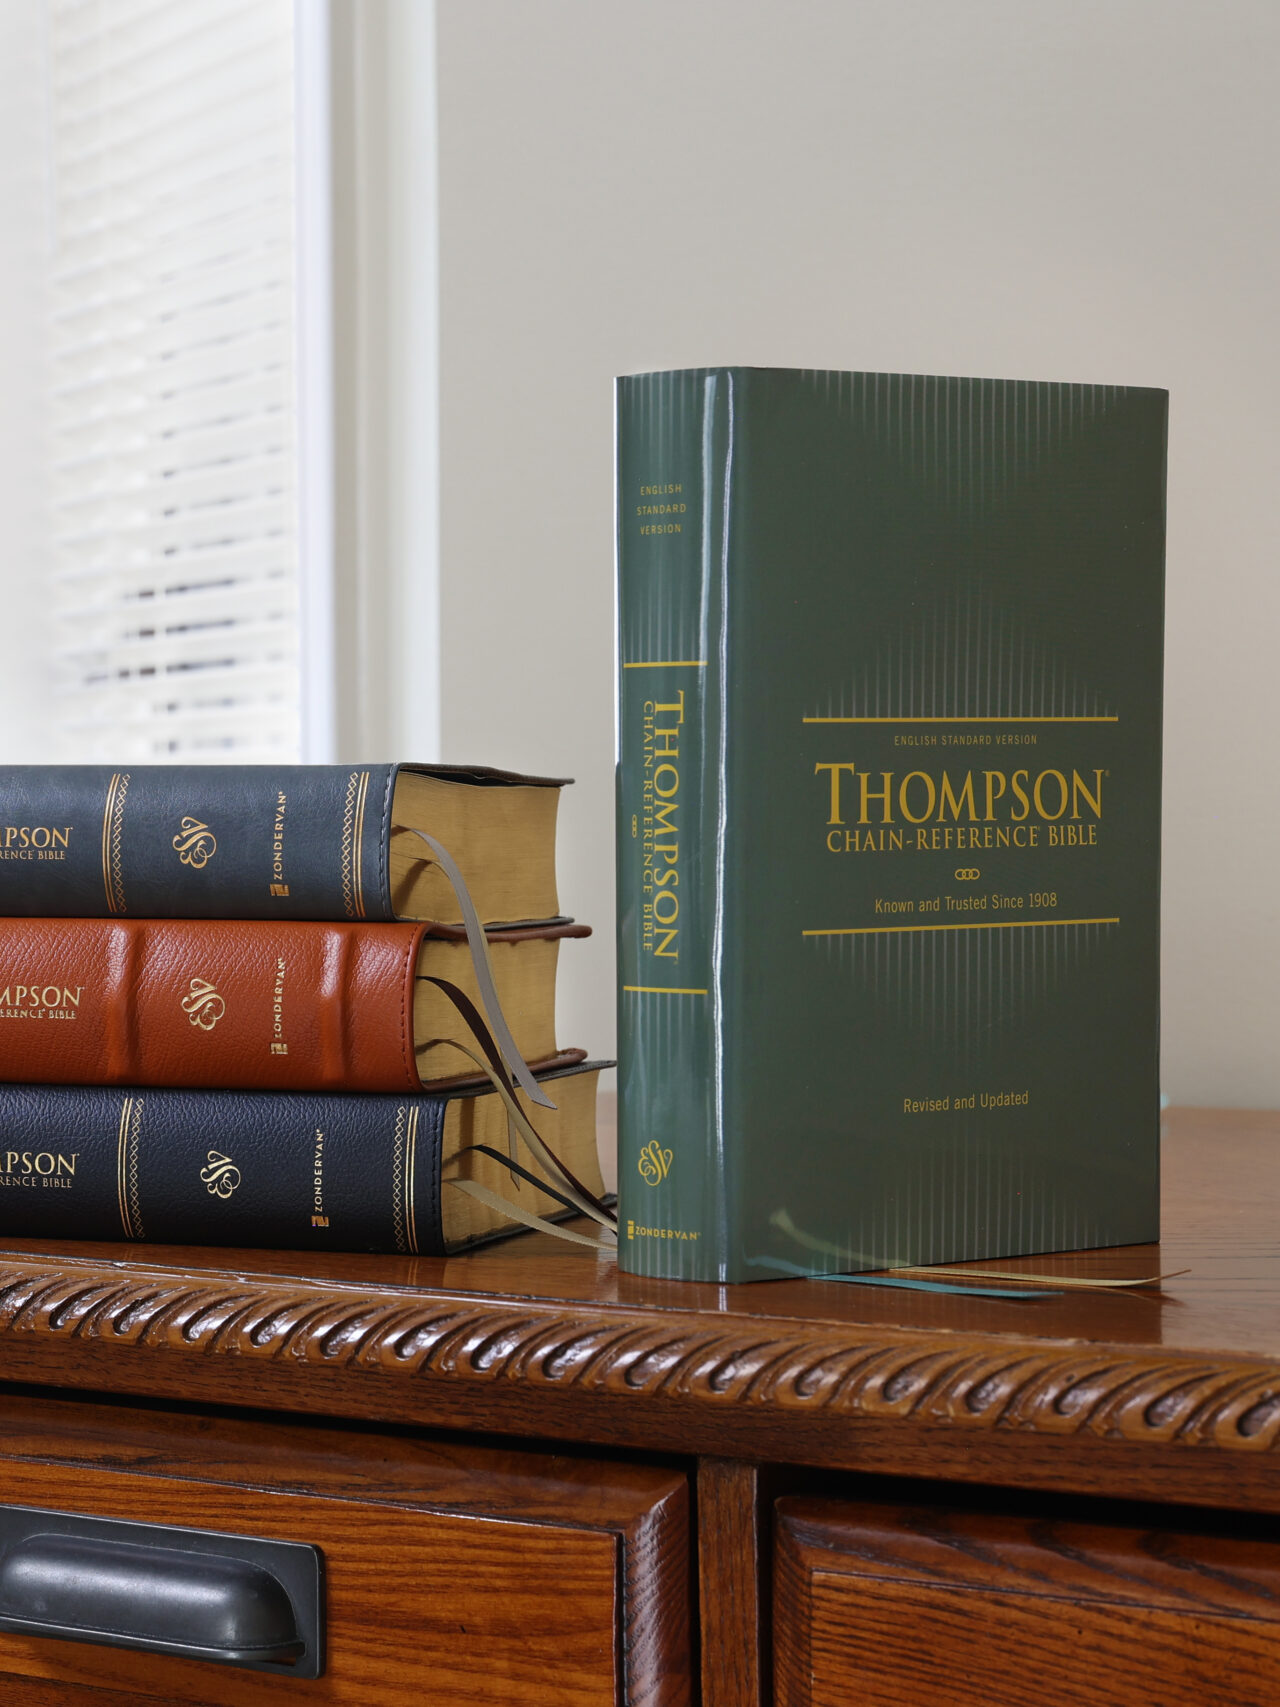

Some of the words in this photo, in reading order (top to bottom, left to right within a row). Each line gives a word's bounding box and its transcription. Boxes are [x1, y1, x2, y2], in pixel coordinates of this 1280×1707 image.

[640, 484, 683, 496] ENGLISH
[636, 503, 687, 516] STANDARD
[639, 523, 682, 535] VERSION
[894, 734, 938, 747] ENGLISH
[941, 733, 992, 746] STANDARD
[995, 732, 1038, 745] VERSION
[814, 762, 1105, 825] THOMPSON
[653, 690, 685, 960] THOMPSON
[273, 793, 287, 880] ZONDERVAN
[826, 825, 1038, 852] CHAIN-REFERENCE
[1048, 823, 1098, 847] BIBLE
[37, 849, 66, 860] BIBLE
[875, 896, 914, 914] Known
[918, 895, 941, 912] and
[945, 895, 987, 911] Trusted
[991, 894, 1024, 910] Since
[1028, 892, 1058, 908] 1908
[642, 903, 654, 952] BIBLE
[48, 1009, 77, 1020] BIBLE
[903, 1096, 949, 1113] Revised
[953, 1095, 976, 1111] and
[980, 1090, 1030, 1112] Updated
[314, 1131, 325, 1213] ZONDERVAN
[42, 1176, 73, 1188] BIBLE
[635, 1226, 698, 1241] ZONDERVAN
